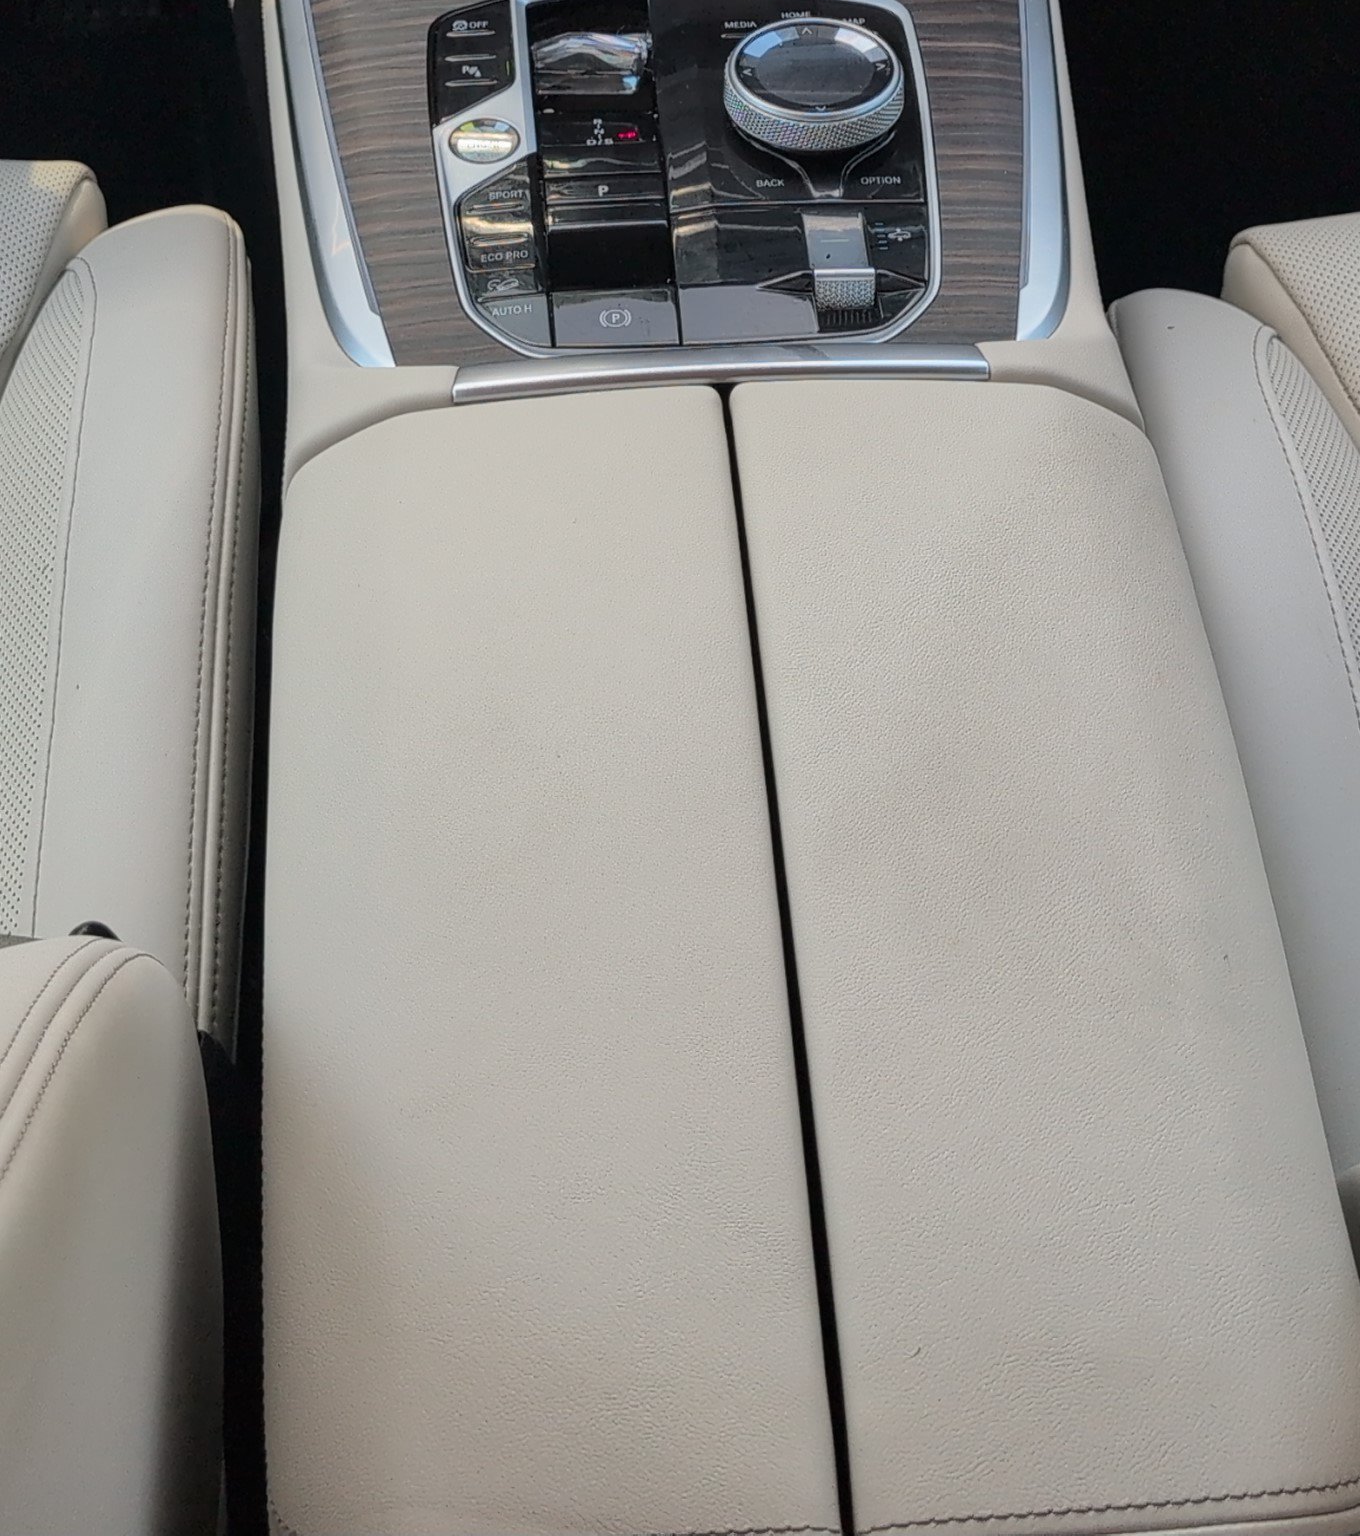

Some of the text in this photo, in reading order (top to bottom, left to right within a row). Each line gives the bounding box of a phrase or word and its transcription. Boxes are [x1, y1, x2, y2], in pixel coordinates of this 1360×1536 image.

[781, 10, 811, 19] HOME
[469, 20, 489, 30] OFF
[724, 20, 758, 30] MEDIA
[755, 178, 785, 188] BACK
[860, 175, 901, 185] OPTION
[489, 189, 525, 200] SPORT
[597, 184, 609, 197] P
[481, 249, 529, 263] ECO PRO
[491, 303, 533, 317] AUTO H
